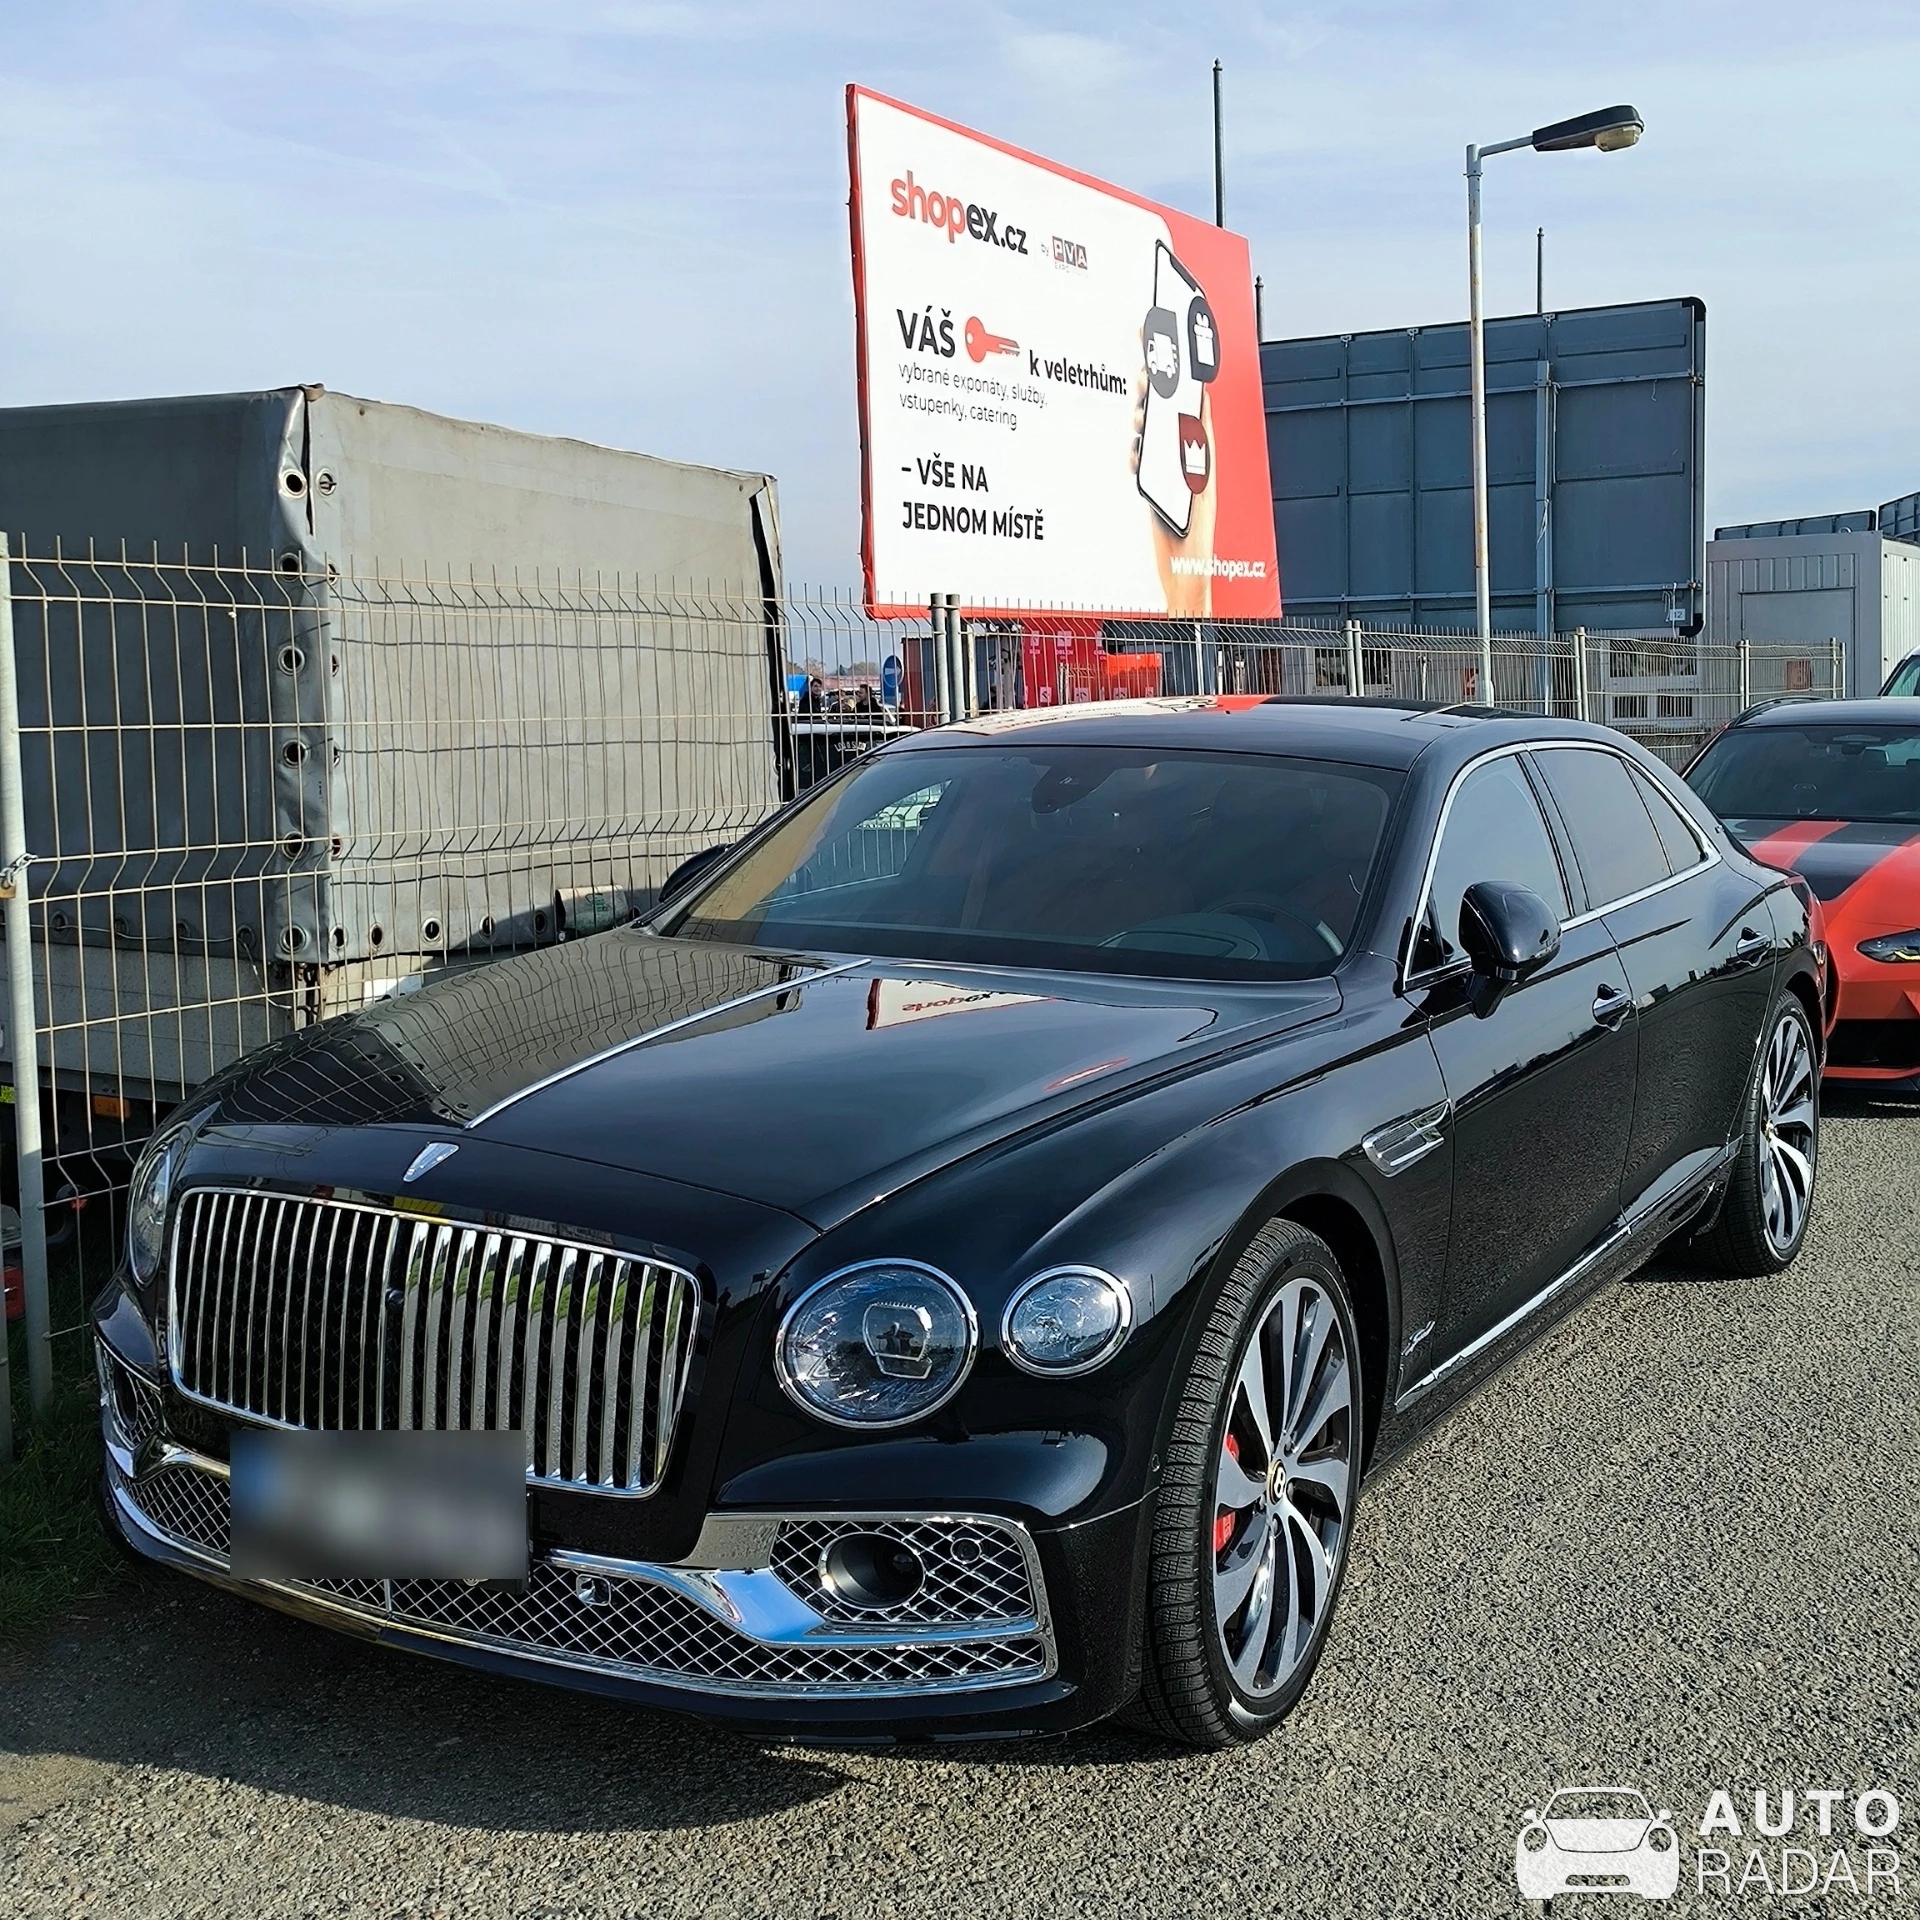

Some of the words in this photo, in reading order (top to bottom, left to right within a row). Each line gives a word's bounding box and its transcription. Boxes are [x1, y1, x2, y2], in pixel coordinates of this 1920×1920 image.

[891, 170, 1028, 255] shopex.cz
[1053, 237, 1088, 269] PVA
[896, 305, 956, 358] VÁŠ
[899, 362, 949, 386] vybrané
[953, 373, 1010, 401] exponáty,
[1029, 349, 1040, 377] k
[1044, 357, 1127, 396] veletrhům:
[899, 392, 968, 422] vstupenky,
[970, 404, 1017, 431] catering
[916, 452, 955, 488] VŠE
[962, 464, 989, 492] NA
[902, 501, 986, 535] JEDNOM
[993, 505, 1044, 541] MÍSTĚ
[1170, 553, 1266, 583] www.shopex.cz
